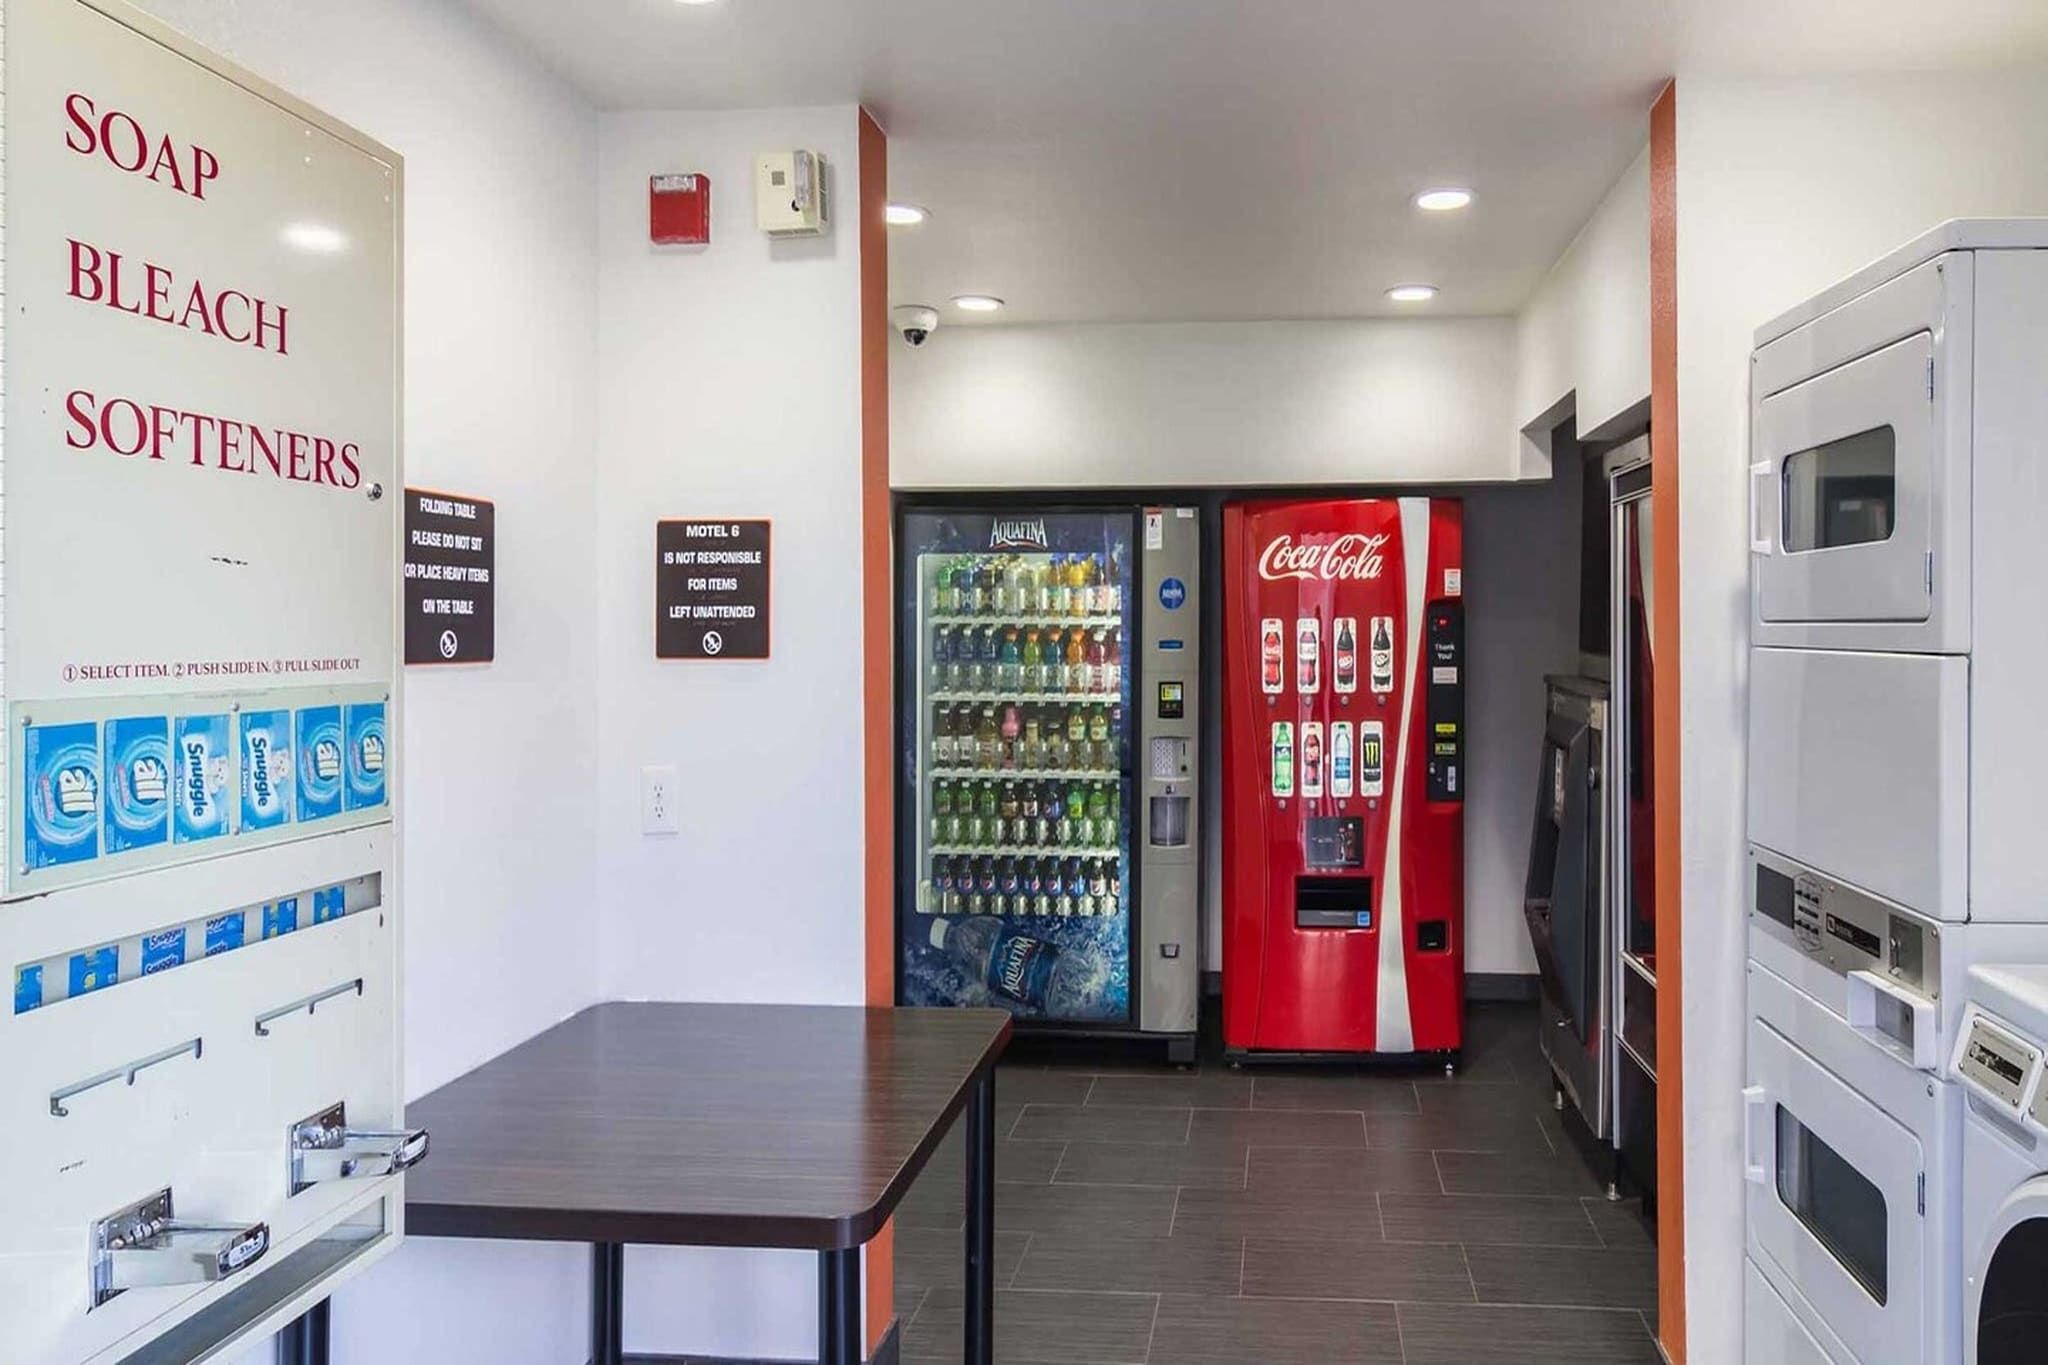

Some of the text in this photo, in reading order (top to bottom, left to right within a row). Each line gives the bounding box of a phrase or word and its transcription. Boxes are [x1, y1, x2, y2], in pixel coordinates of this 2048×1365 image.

[64, 94, 220, 200] SOAP
[66, 238, 288, 355] BLEACH
[65, 392, 361, 488] SOFTENERS
[420, 497, 477, 519] FOLDING TABLE
[412, 530, 483, 551] PLEASE DO NOT SIT
[685, 524, 741, 538] MOTEL 6
[988, 516, 1049, 549] AQUAFINA
[663, 551, 674, 565] IS
[675, 551, 696, 565] NOT
[1258, 532, 1391, 580] Coca-Cola
[404, 562, 489, 583] OR PLACE HEAVY ITEMS
[687, 578, 738, 591] FOR ITEMS
[422, 599, 474, 615] ON THE TABLE
[669, 605, 756, 619] LEFT UNATTENDED
[1434, 643, 1456, 652] Thank
[80, 664, 132, 681] SELECT
[186, 661, 220, 677] PUSH
[221, 660, 256, 676] SLIDE
[284, 659, 309, 673] PULL
[310, 658, 340, 672] SLIDE
[340, 658, 361, 671] OUT
[186, 742, 208, 817] Snuggle
[252, 737, 272, 807] Snuggle
[1001, 935, 1037, 999] AQUAFINA
